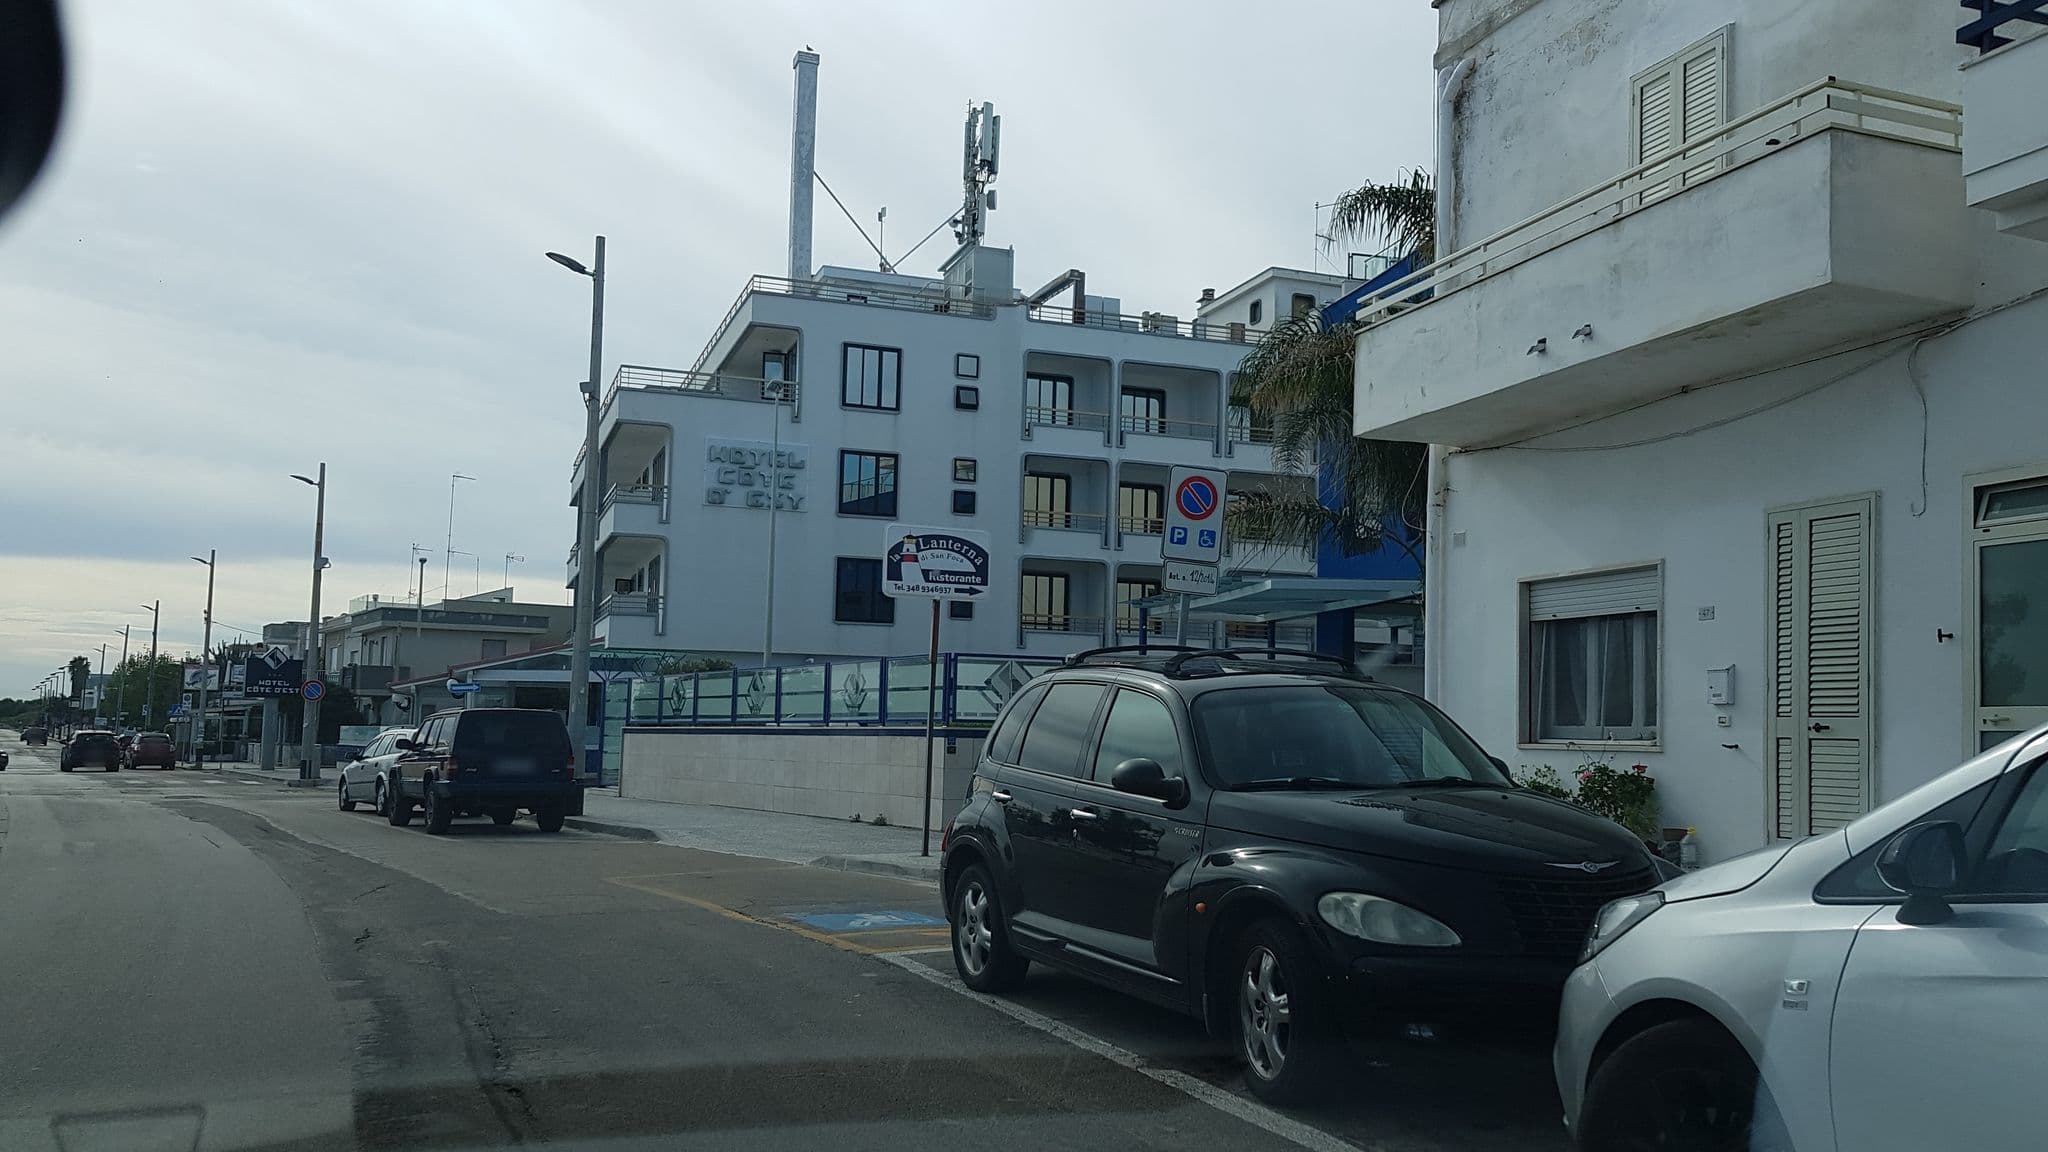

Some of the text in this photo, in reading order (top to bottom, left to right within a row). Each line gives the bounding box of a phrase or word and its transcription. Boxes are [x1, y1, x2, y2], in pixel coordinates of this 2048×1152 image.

[709, 445, 805, 469] HOTEL
[918, 537, 985, 567] Lanterna
[920, 553, 929, 562] di
[930, 552, 945, 560] San
[906, 584, 920, 592] 348
[258, 679, 290, 687] HOTEL
